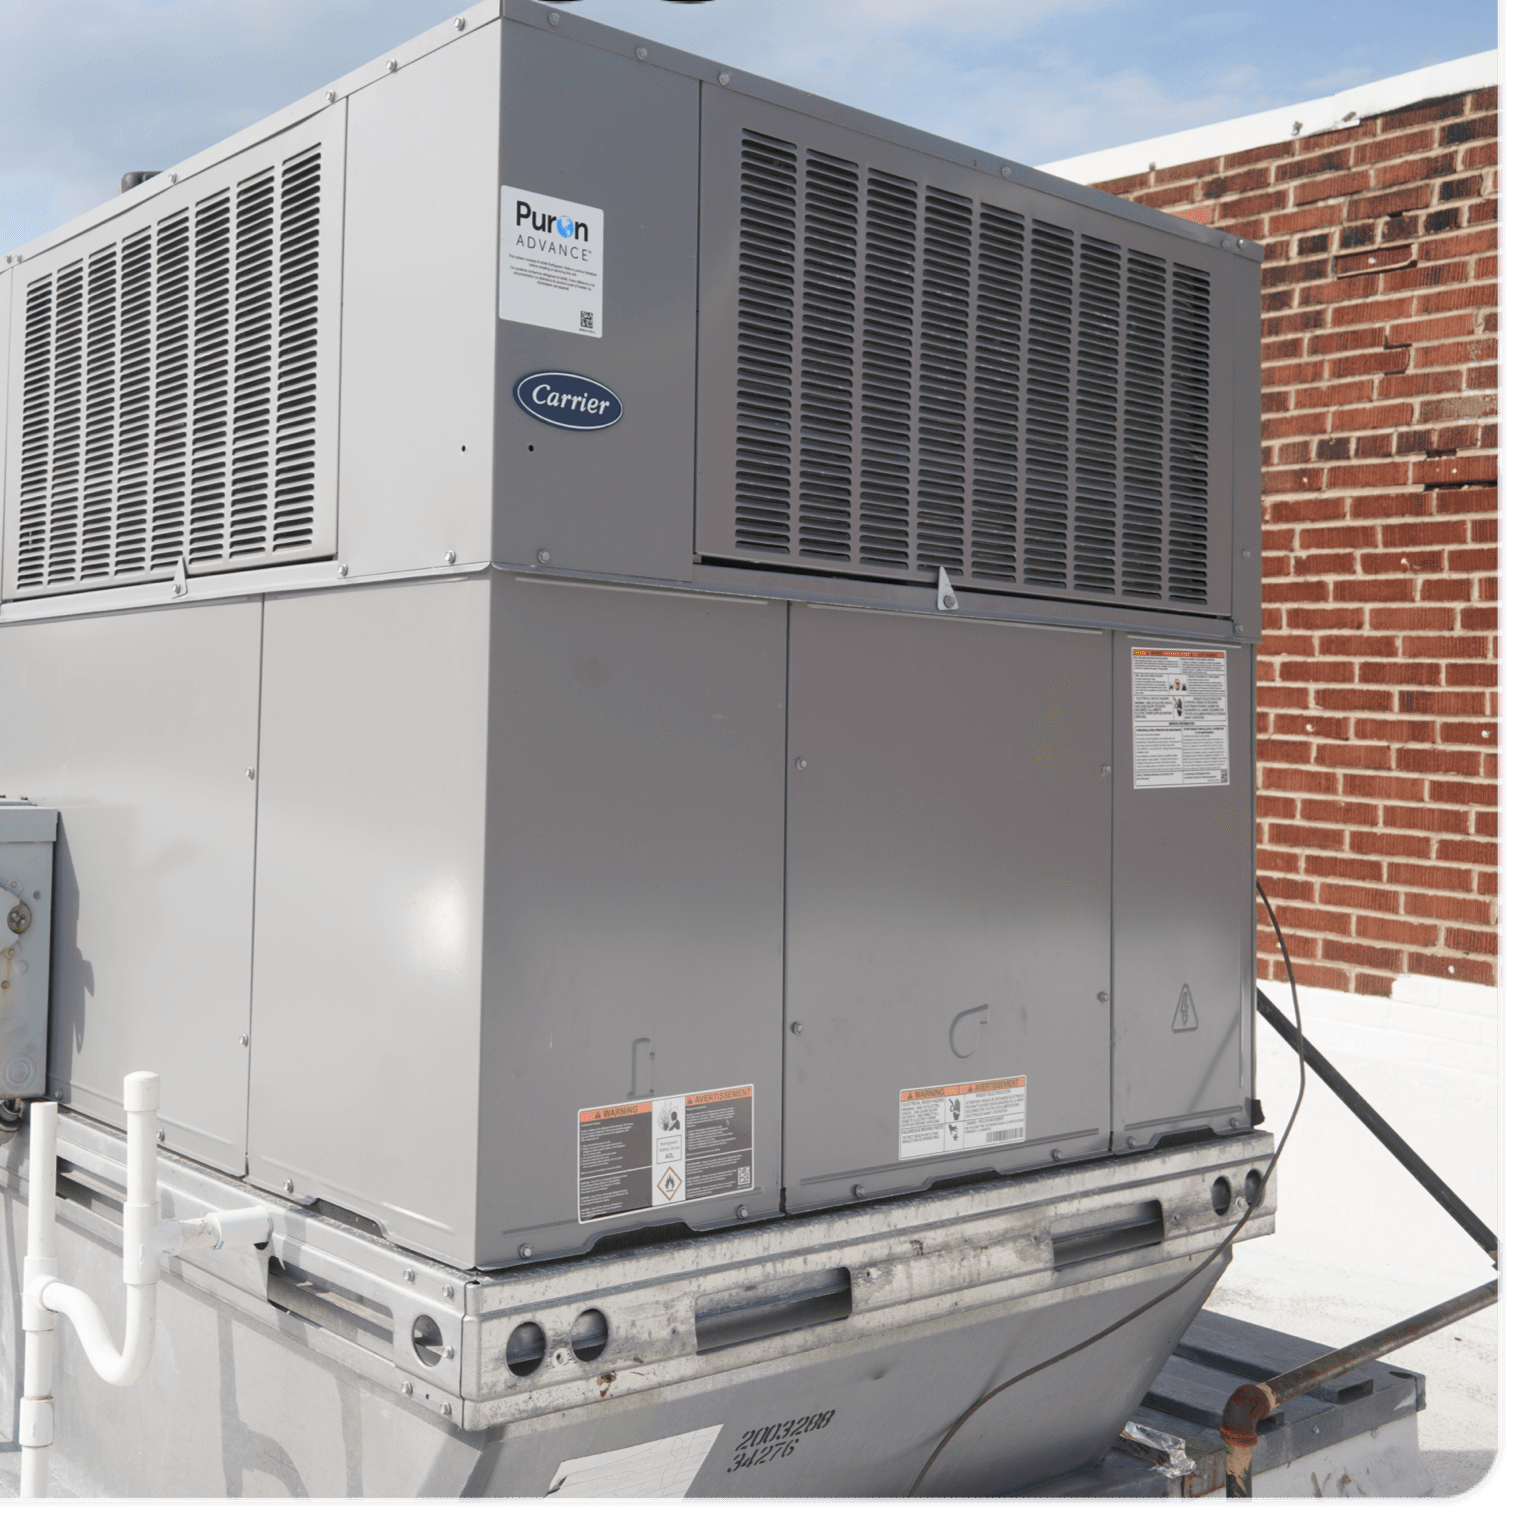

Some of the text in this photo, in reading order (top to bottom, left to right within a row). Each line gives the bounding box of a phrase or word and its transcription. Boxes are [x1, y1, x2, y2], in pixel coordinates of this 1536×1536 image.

[516, 200, 588, 242] Puron
[516, 234, 589, 261] ADVANCE
[532, 383, 610, 415] Carrier
[694, 1087, 752, 1103] AVERTISSEMENT
[915, 1087, 945, 1098] WARNING
[603, 1105, 639, 1118] WARNING
